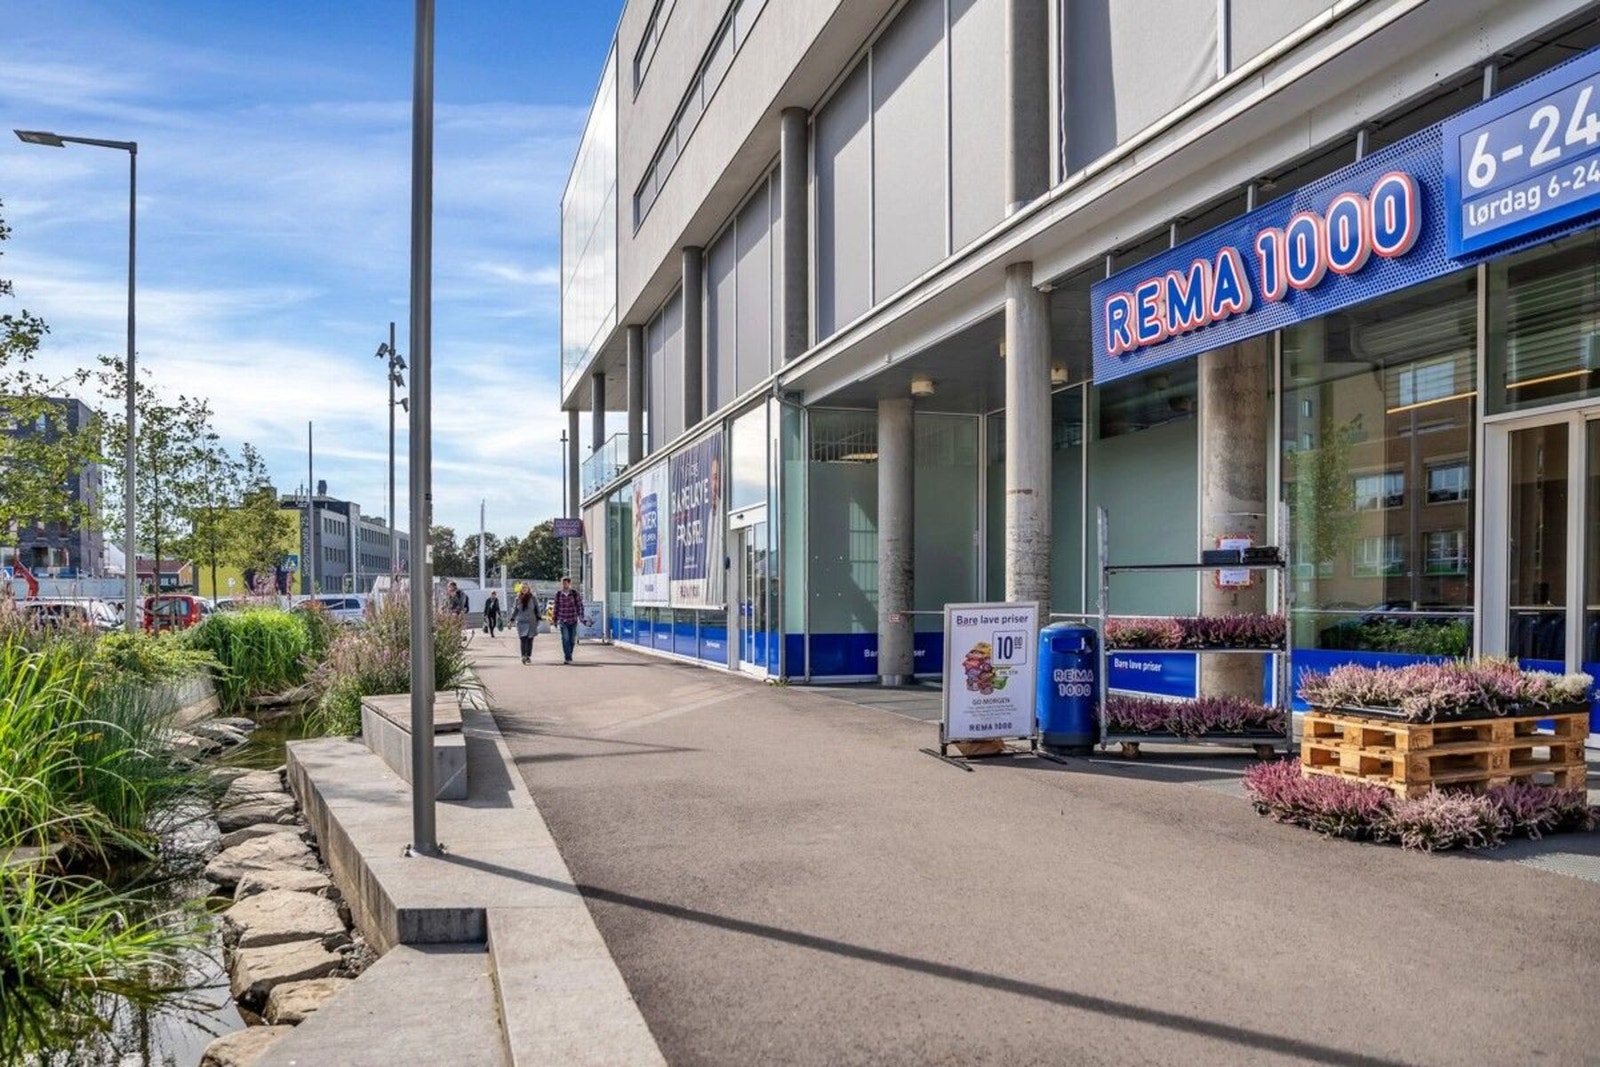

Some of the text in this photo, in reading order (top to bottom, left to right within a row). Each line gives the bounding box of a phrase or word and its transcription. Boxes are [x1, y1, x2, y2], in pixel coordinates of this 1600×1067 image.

[1468, 86, 1600, 188] 6-24
[1469, 160, 1600, 227] lørdag 6-24
[1105, 171, 1420, 355] REMA 1000
[956, 614, 1028, 625] Bare lave priser
[864, 649, 926, 657] Bar ser
[997, 636, 1013, 660] 10
[1114, 657, 1162, 672] Bare lave priser
[1054, 669, 1094, 682] REMA
[1058, 683, 1092, 697] 1000
[995, 722, 1012, 730] 1000
